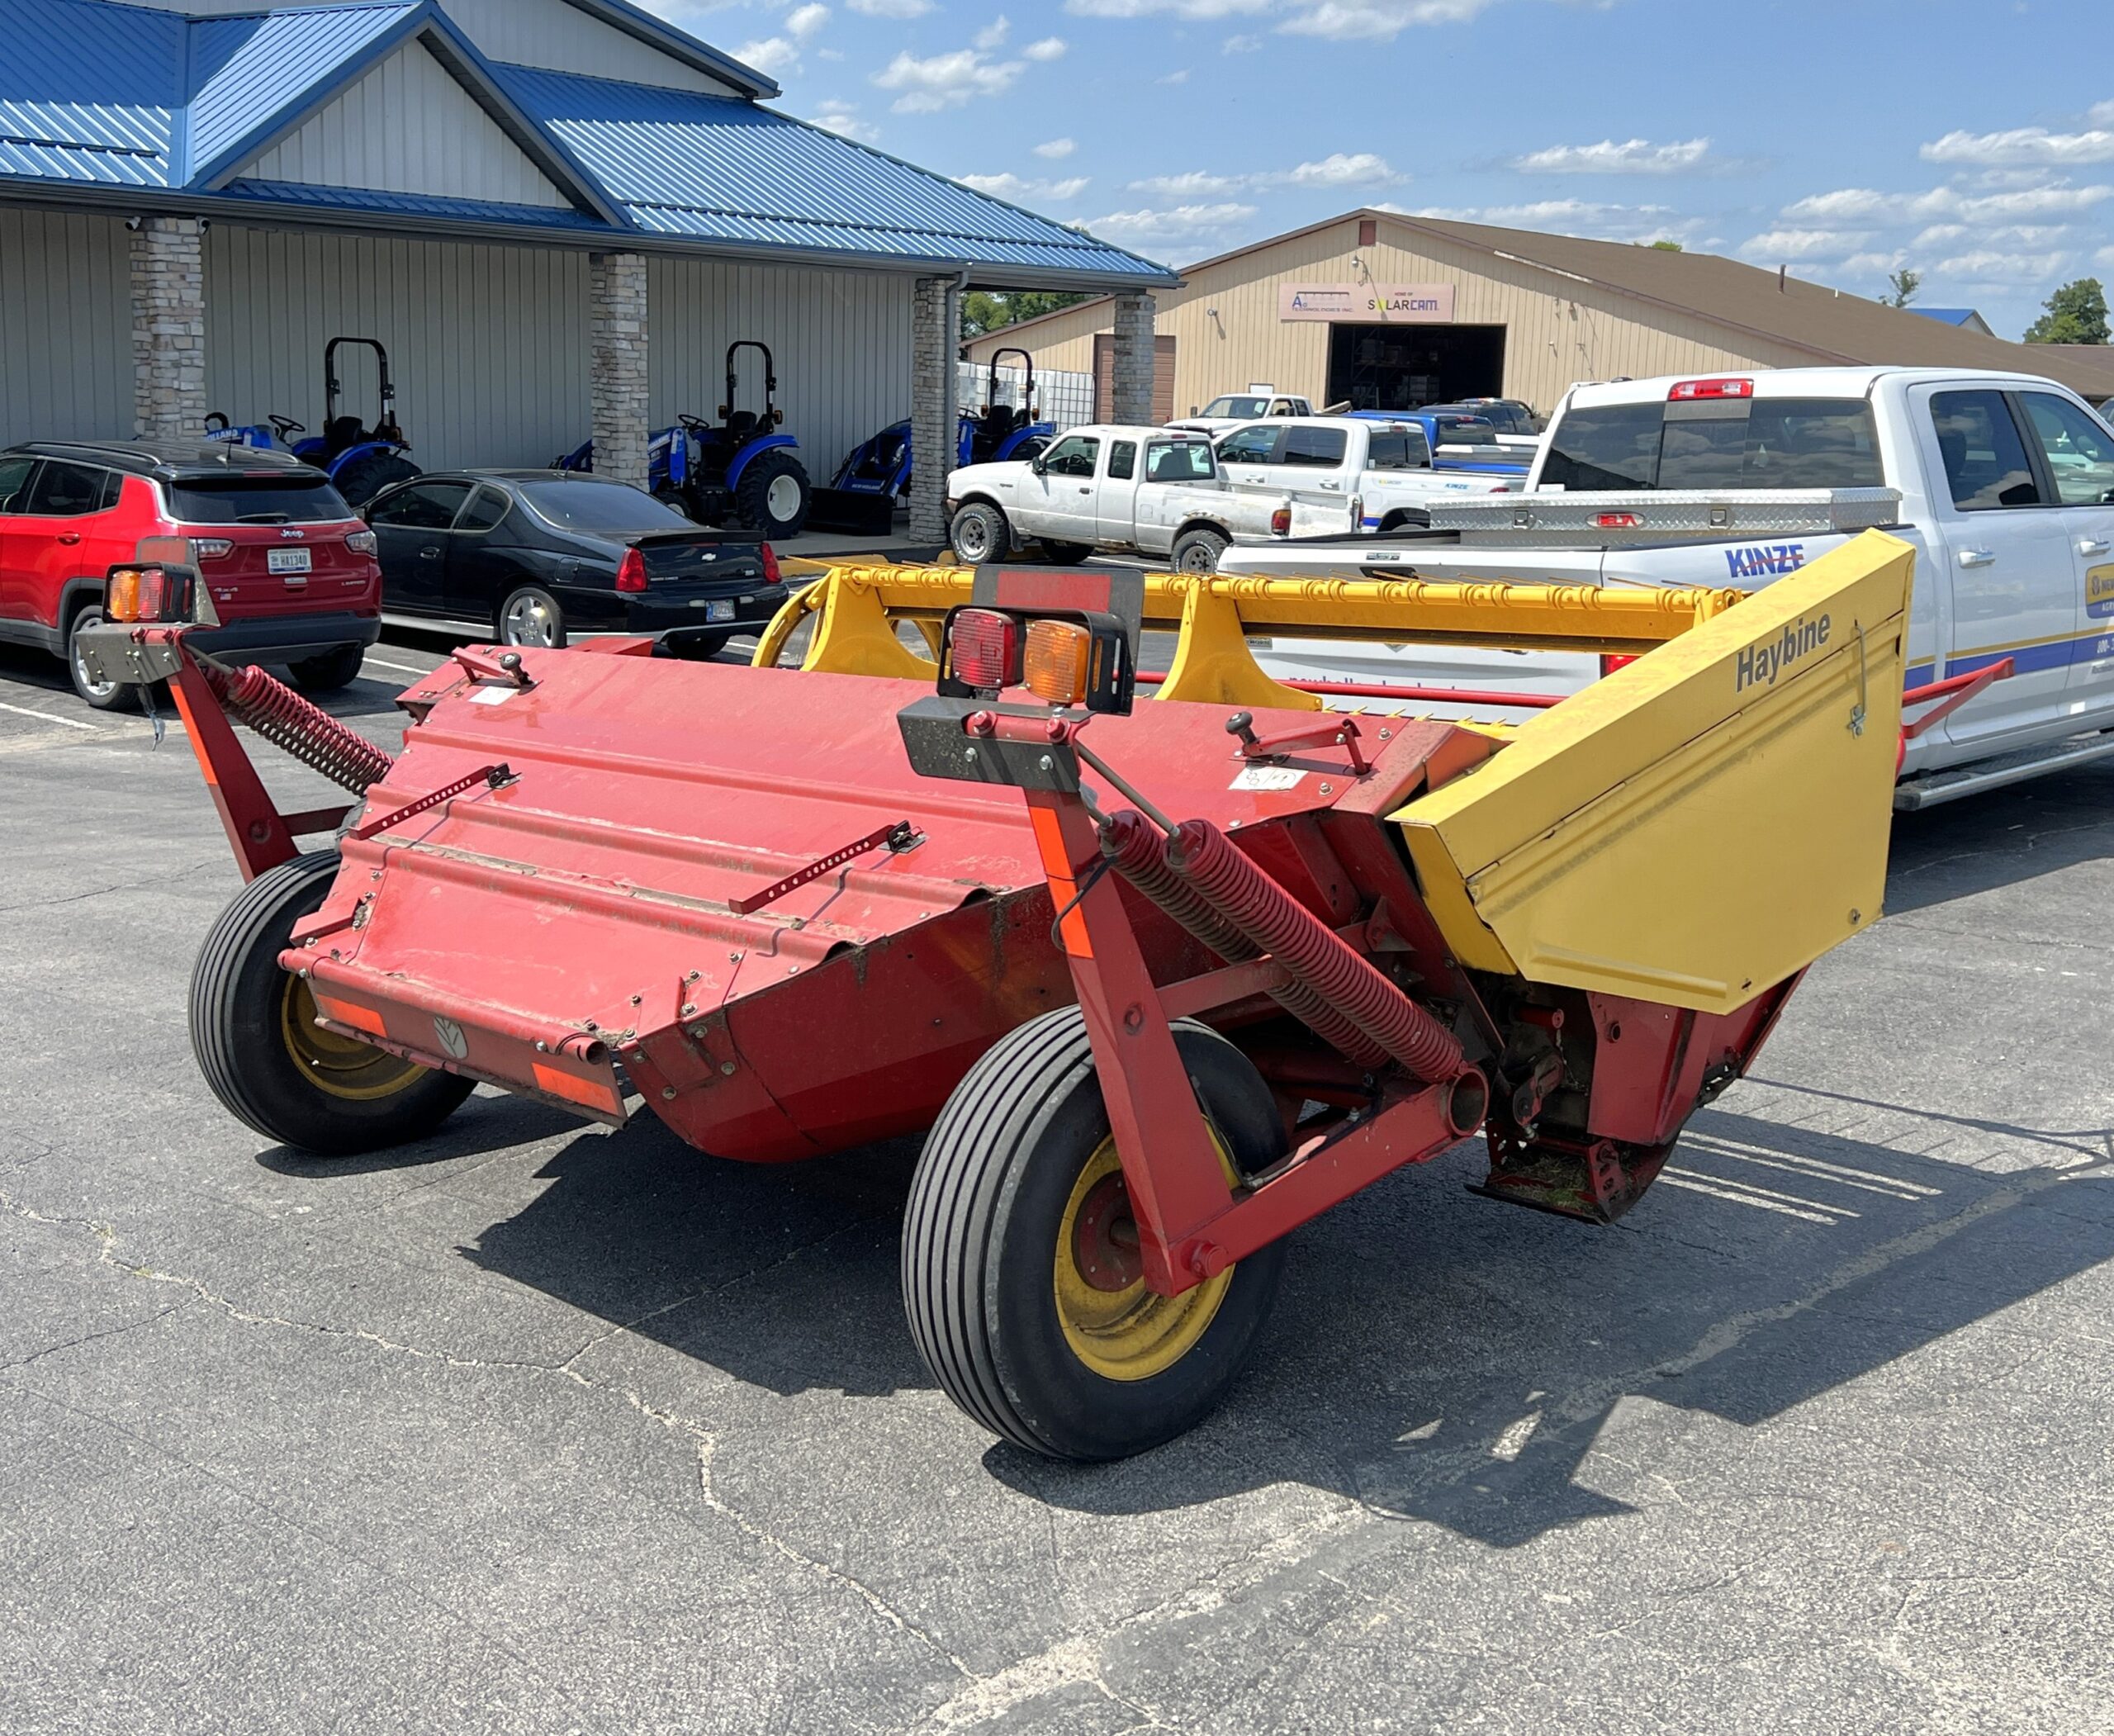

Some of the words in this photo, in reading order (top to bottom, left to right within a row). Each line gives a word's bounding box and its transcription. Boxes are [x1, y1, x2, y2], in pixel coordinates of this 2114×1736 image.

[280, 529, 304, 538] Jeep
[1724, 544, 1806, 578] KINZE
[1737, 613, 1830, 693] Haybine
